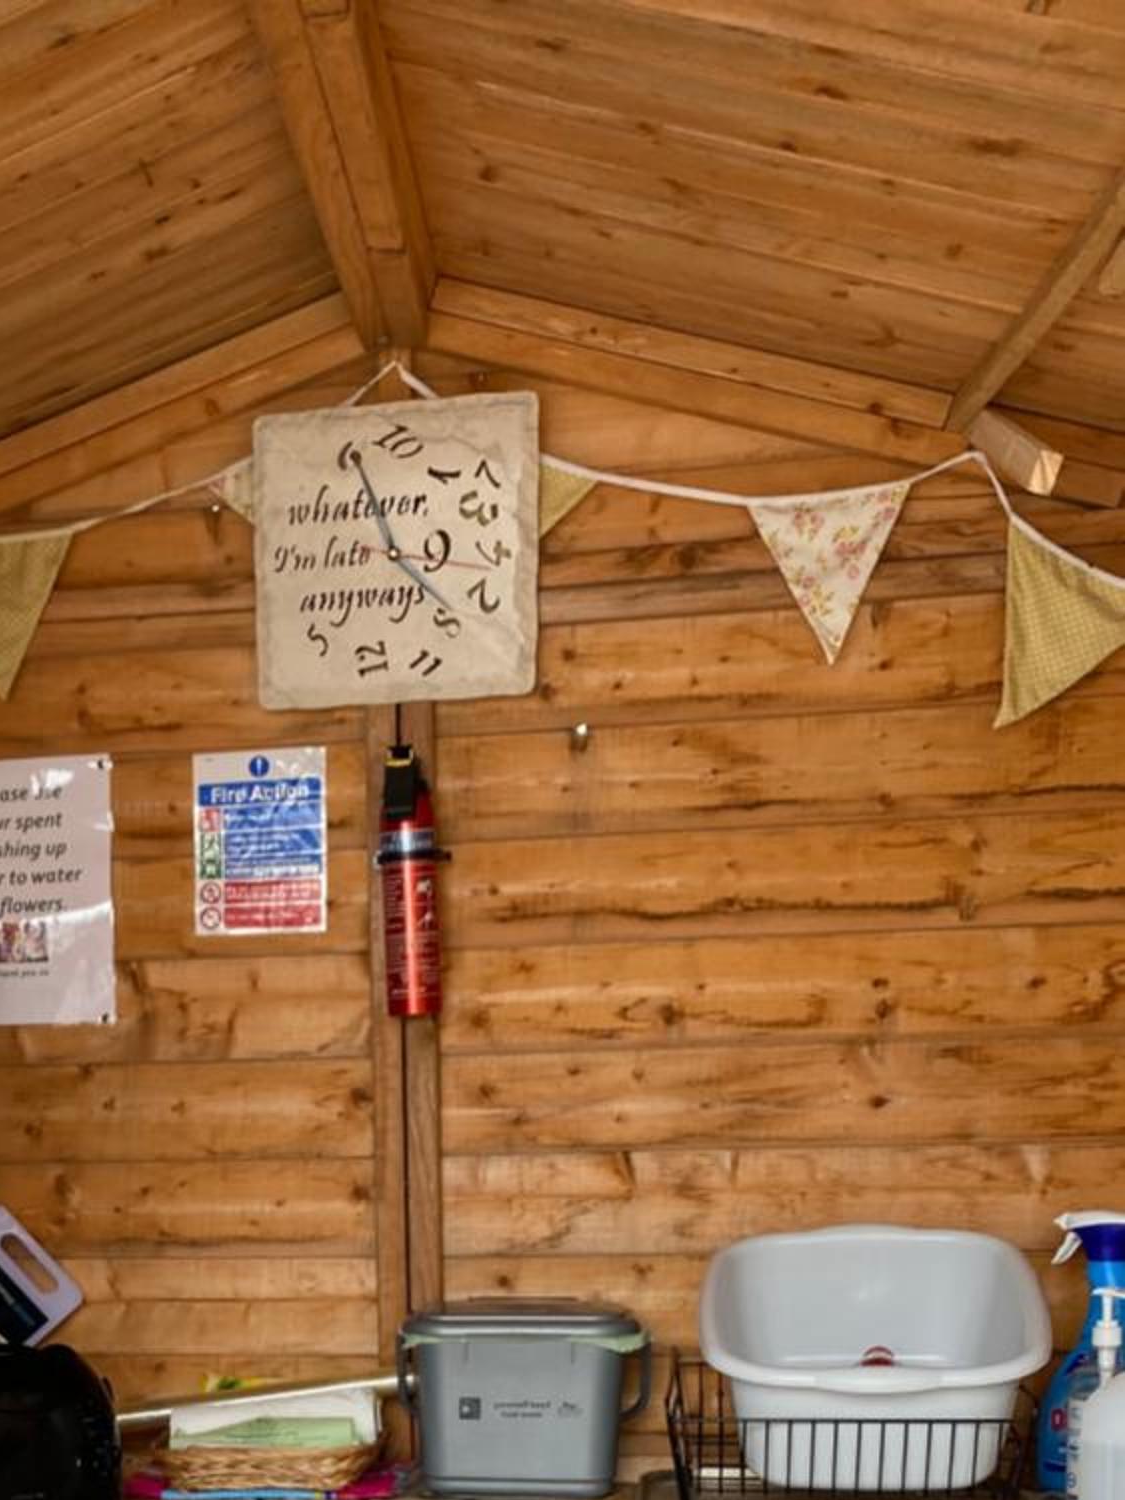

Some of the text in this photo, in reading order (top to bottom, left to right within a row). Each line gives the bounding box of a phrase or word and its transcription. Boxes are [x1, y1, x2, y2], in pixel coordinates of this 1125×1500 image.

[459, 490, 499, 526] 3
[325, 536, 370, 569] late
[423, 529, 451, 573] 9
[299, 585, 425, 628] anyways
[211, 782, 309, 803] Fire Action
[16, 813, 62, 832] spent
[46, 843, 67, 858] up
[9, 870, 26, 885] to
[31, 869, 82, 884] water
